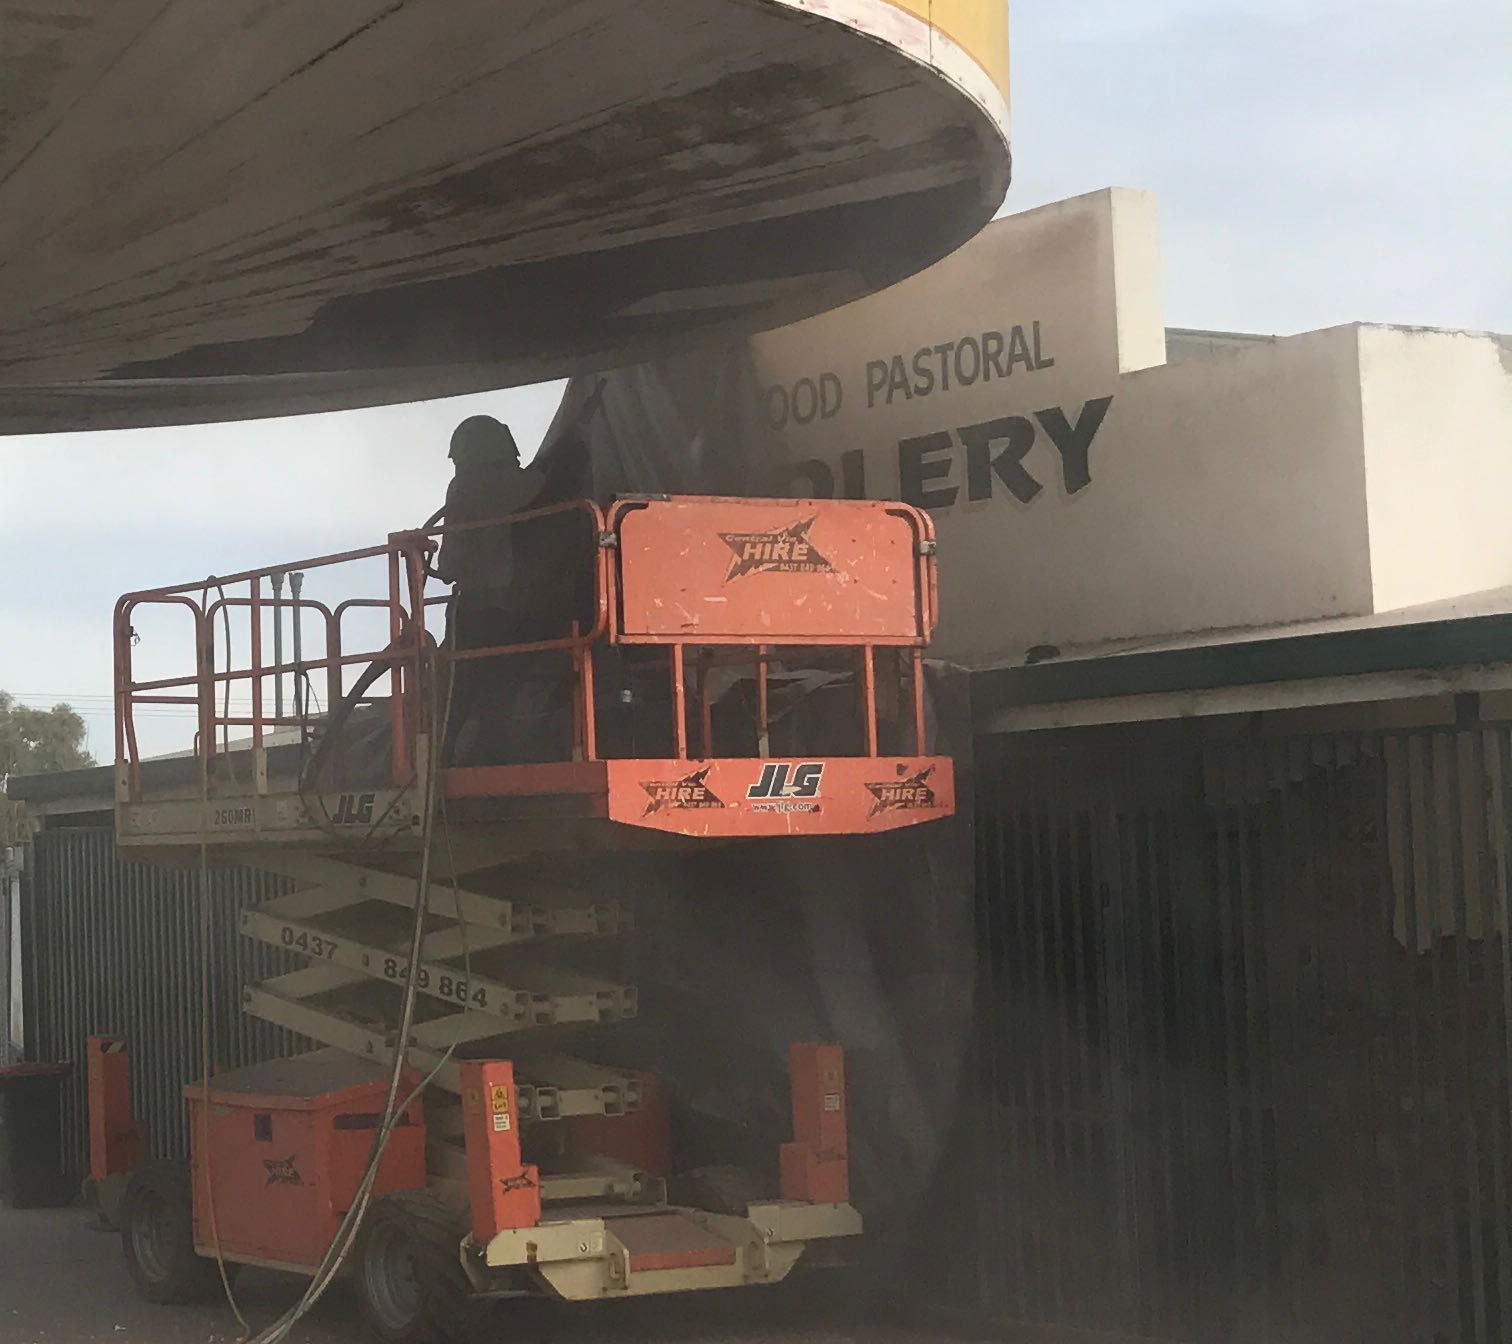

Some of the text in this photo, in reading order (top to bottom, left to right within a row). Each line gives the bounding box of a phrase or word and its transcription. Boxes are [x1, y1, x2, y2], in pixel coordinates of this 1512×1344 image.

[867, 320, 1055, 408] PASTORAL
[743, 542, 809, 560] HIRE
[655, 787, 706, 800] HIRE
[746, 763, 825, 799] JLG
[880, 788, 928, 801] HIRE
[332, 794, 375, 824] JLG
[281, 926, 338, 959] 0437
[438, 975, 487, 1008] 864
